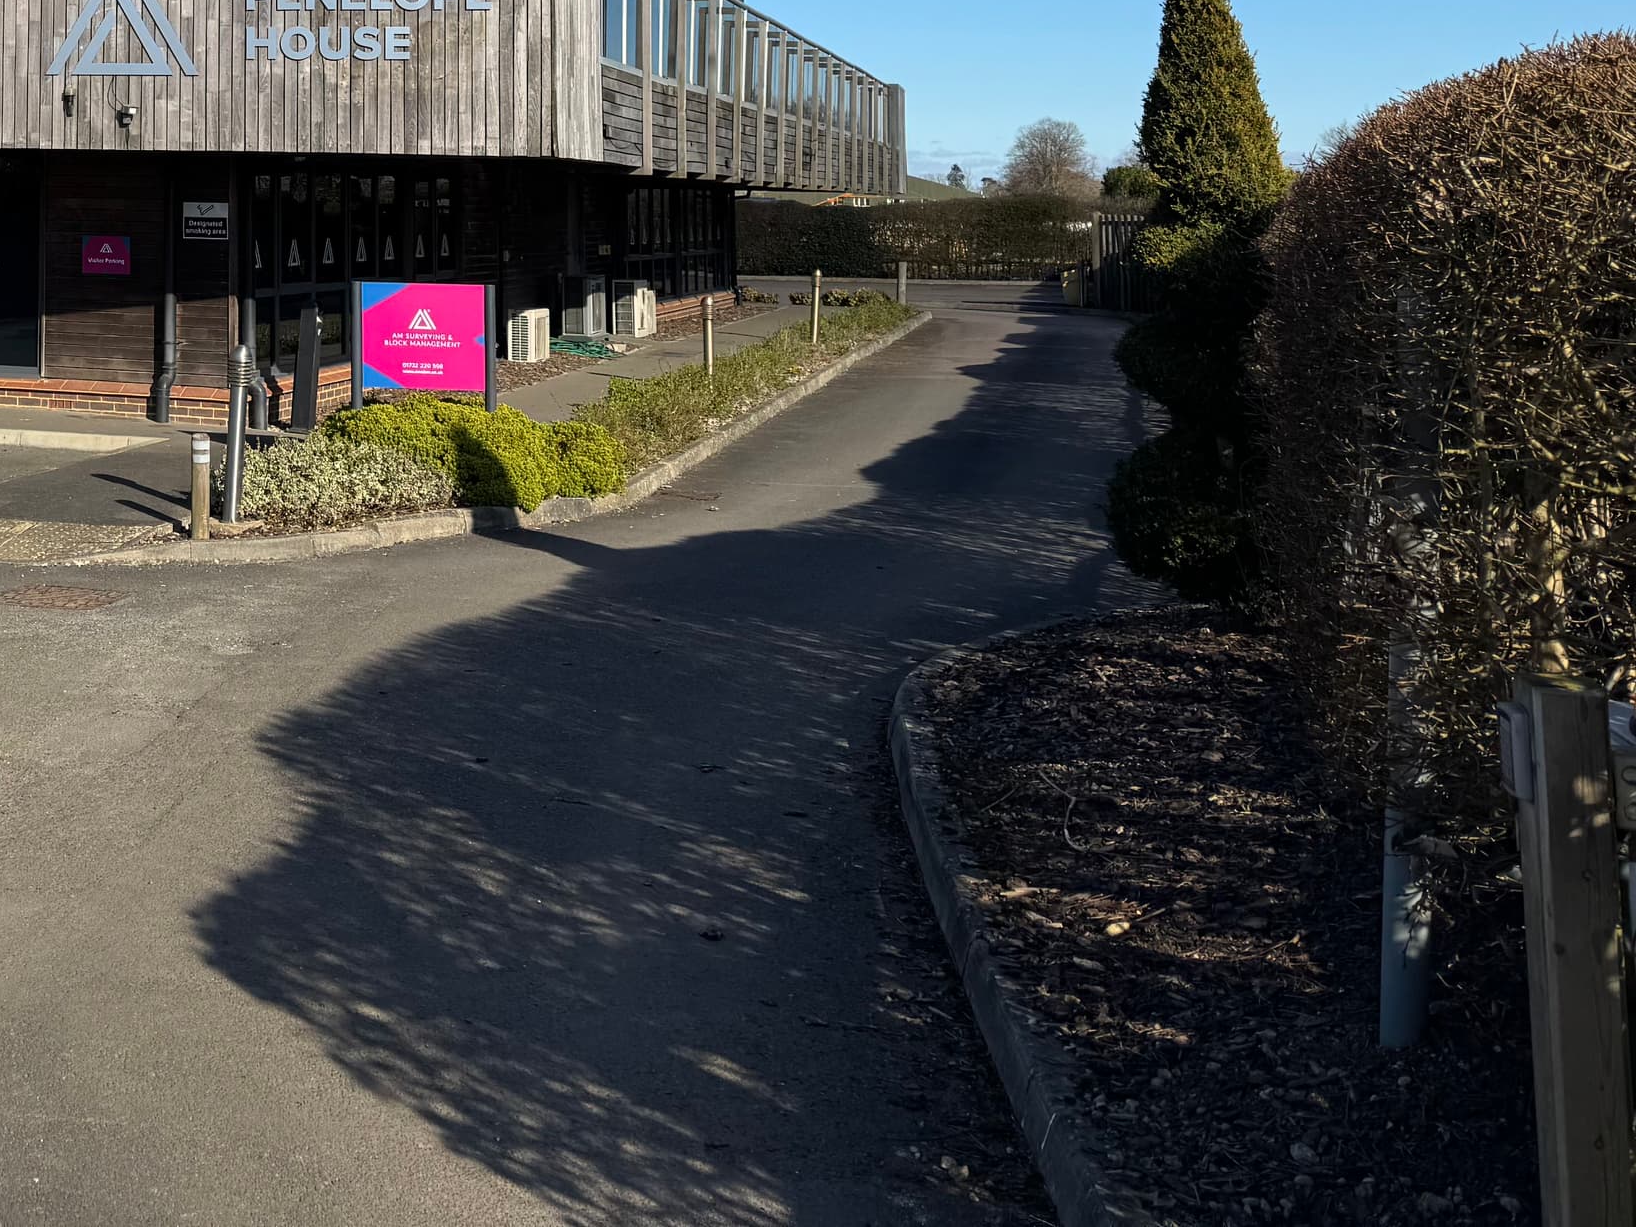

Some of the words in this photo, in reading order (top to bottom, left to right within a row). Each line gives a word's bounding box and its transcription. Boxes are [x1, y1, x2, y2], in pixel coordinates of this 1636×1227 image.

[245, 26, 411, 61] HOUSE
[405, 333, 446, 341] SURVEYING
[409, 340, 461, 348] MANAGEMENT
